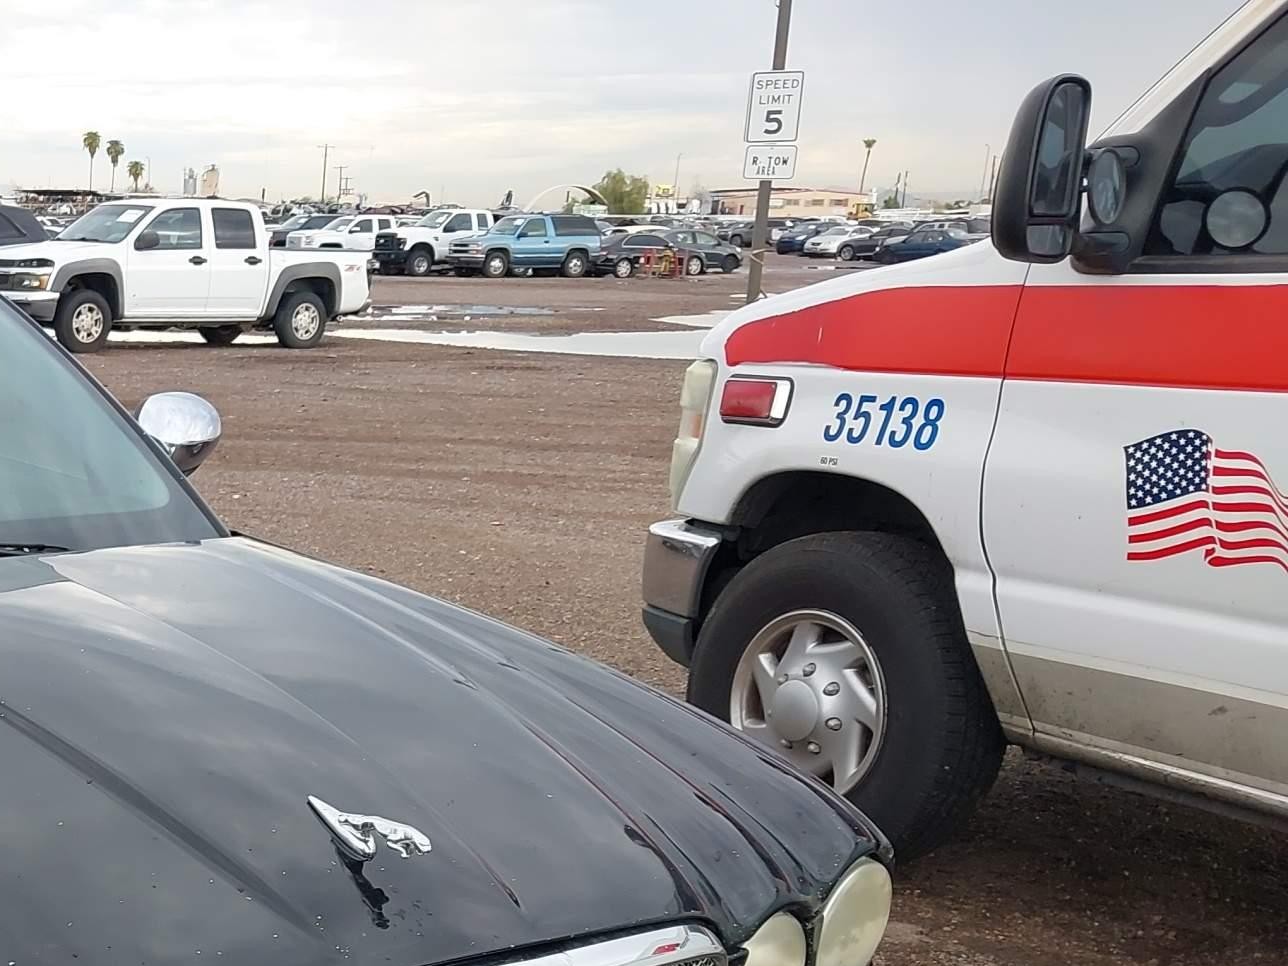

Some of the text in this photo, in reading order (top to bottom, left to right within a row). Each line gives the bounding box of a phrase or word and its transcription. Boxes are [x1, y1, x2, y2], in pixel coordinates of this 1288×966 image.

[756, 79, 800, 90] SPEED
[758, 94, 793, 105] LIMIT
[763, 110, 783, 135] 5
[768, 156, 790, 167] TOW
[755, 166, 776, 176] AREA
[823, 392, 945, 451] 35138
[820, 456, 838, 466] 60 PSI
